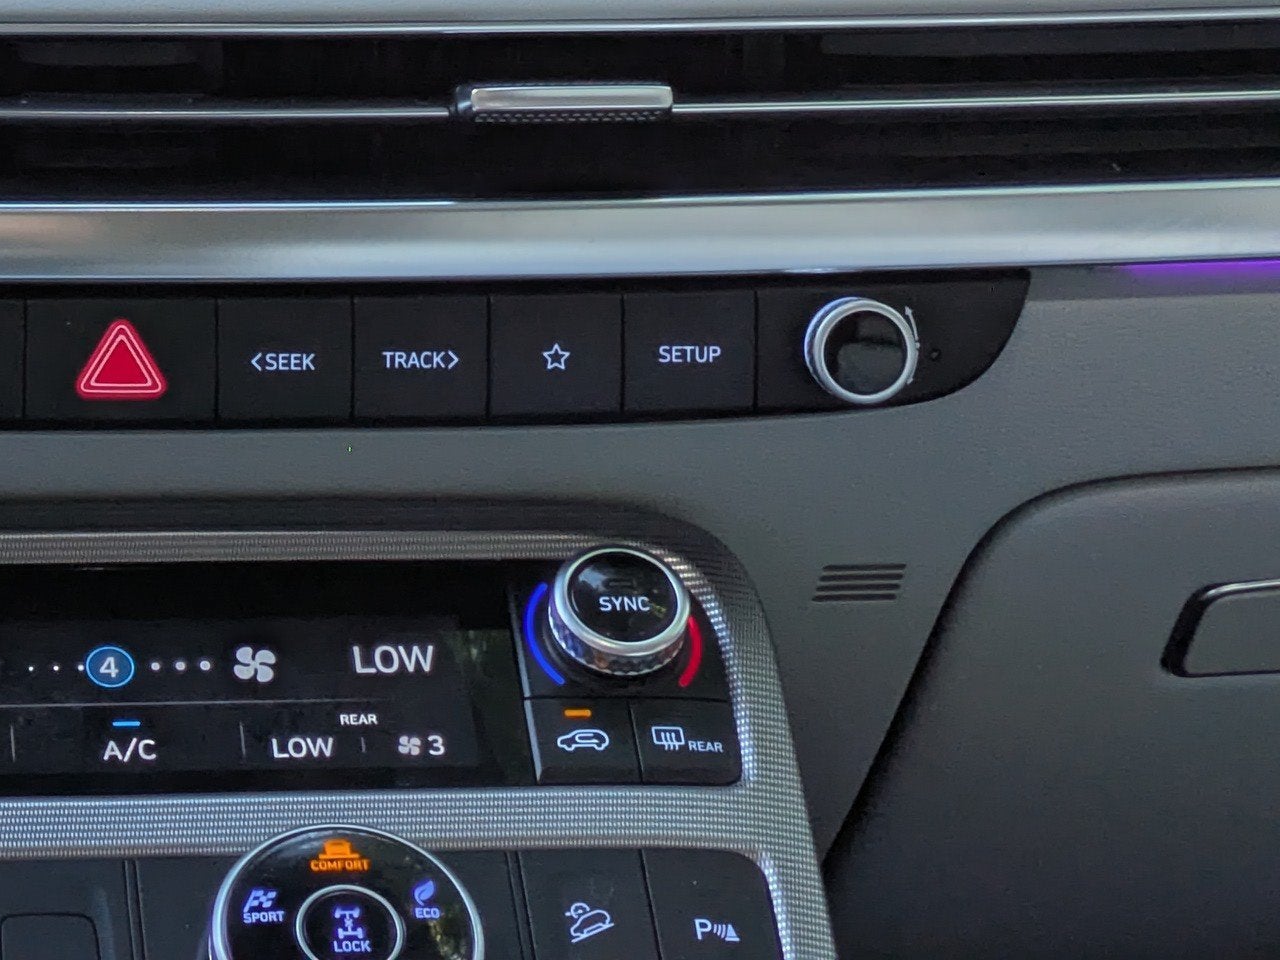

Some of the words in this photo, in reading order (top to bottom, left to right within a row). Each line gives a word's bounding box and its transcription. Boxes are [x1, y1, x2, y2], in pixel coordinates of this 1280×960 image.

[265, 352, 316, 372] SEEK
[382, 351, 447, 370] TRACK
[657, 345, 722, 364] SETUP
[598, 596, 651, 612] SYNC
[98, 655, 119, 679] 4
[352, 644, 435, 675] LOW
[339, 713, 378, 726] REAR
[102, 737, 158, 762] A/C
[271, 738, 334, 759] LOW
[428, 735, 446, 757] 3
[688, 740, 724, 753] REAR
[310, 859, 369, 872] COMFORT
[243, 910, 286, 924] SPORT
[414, 907, 441, 920] ECO
[333, 940, 372, 953] LOCK
